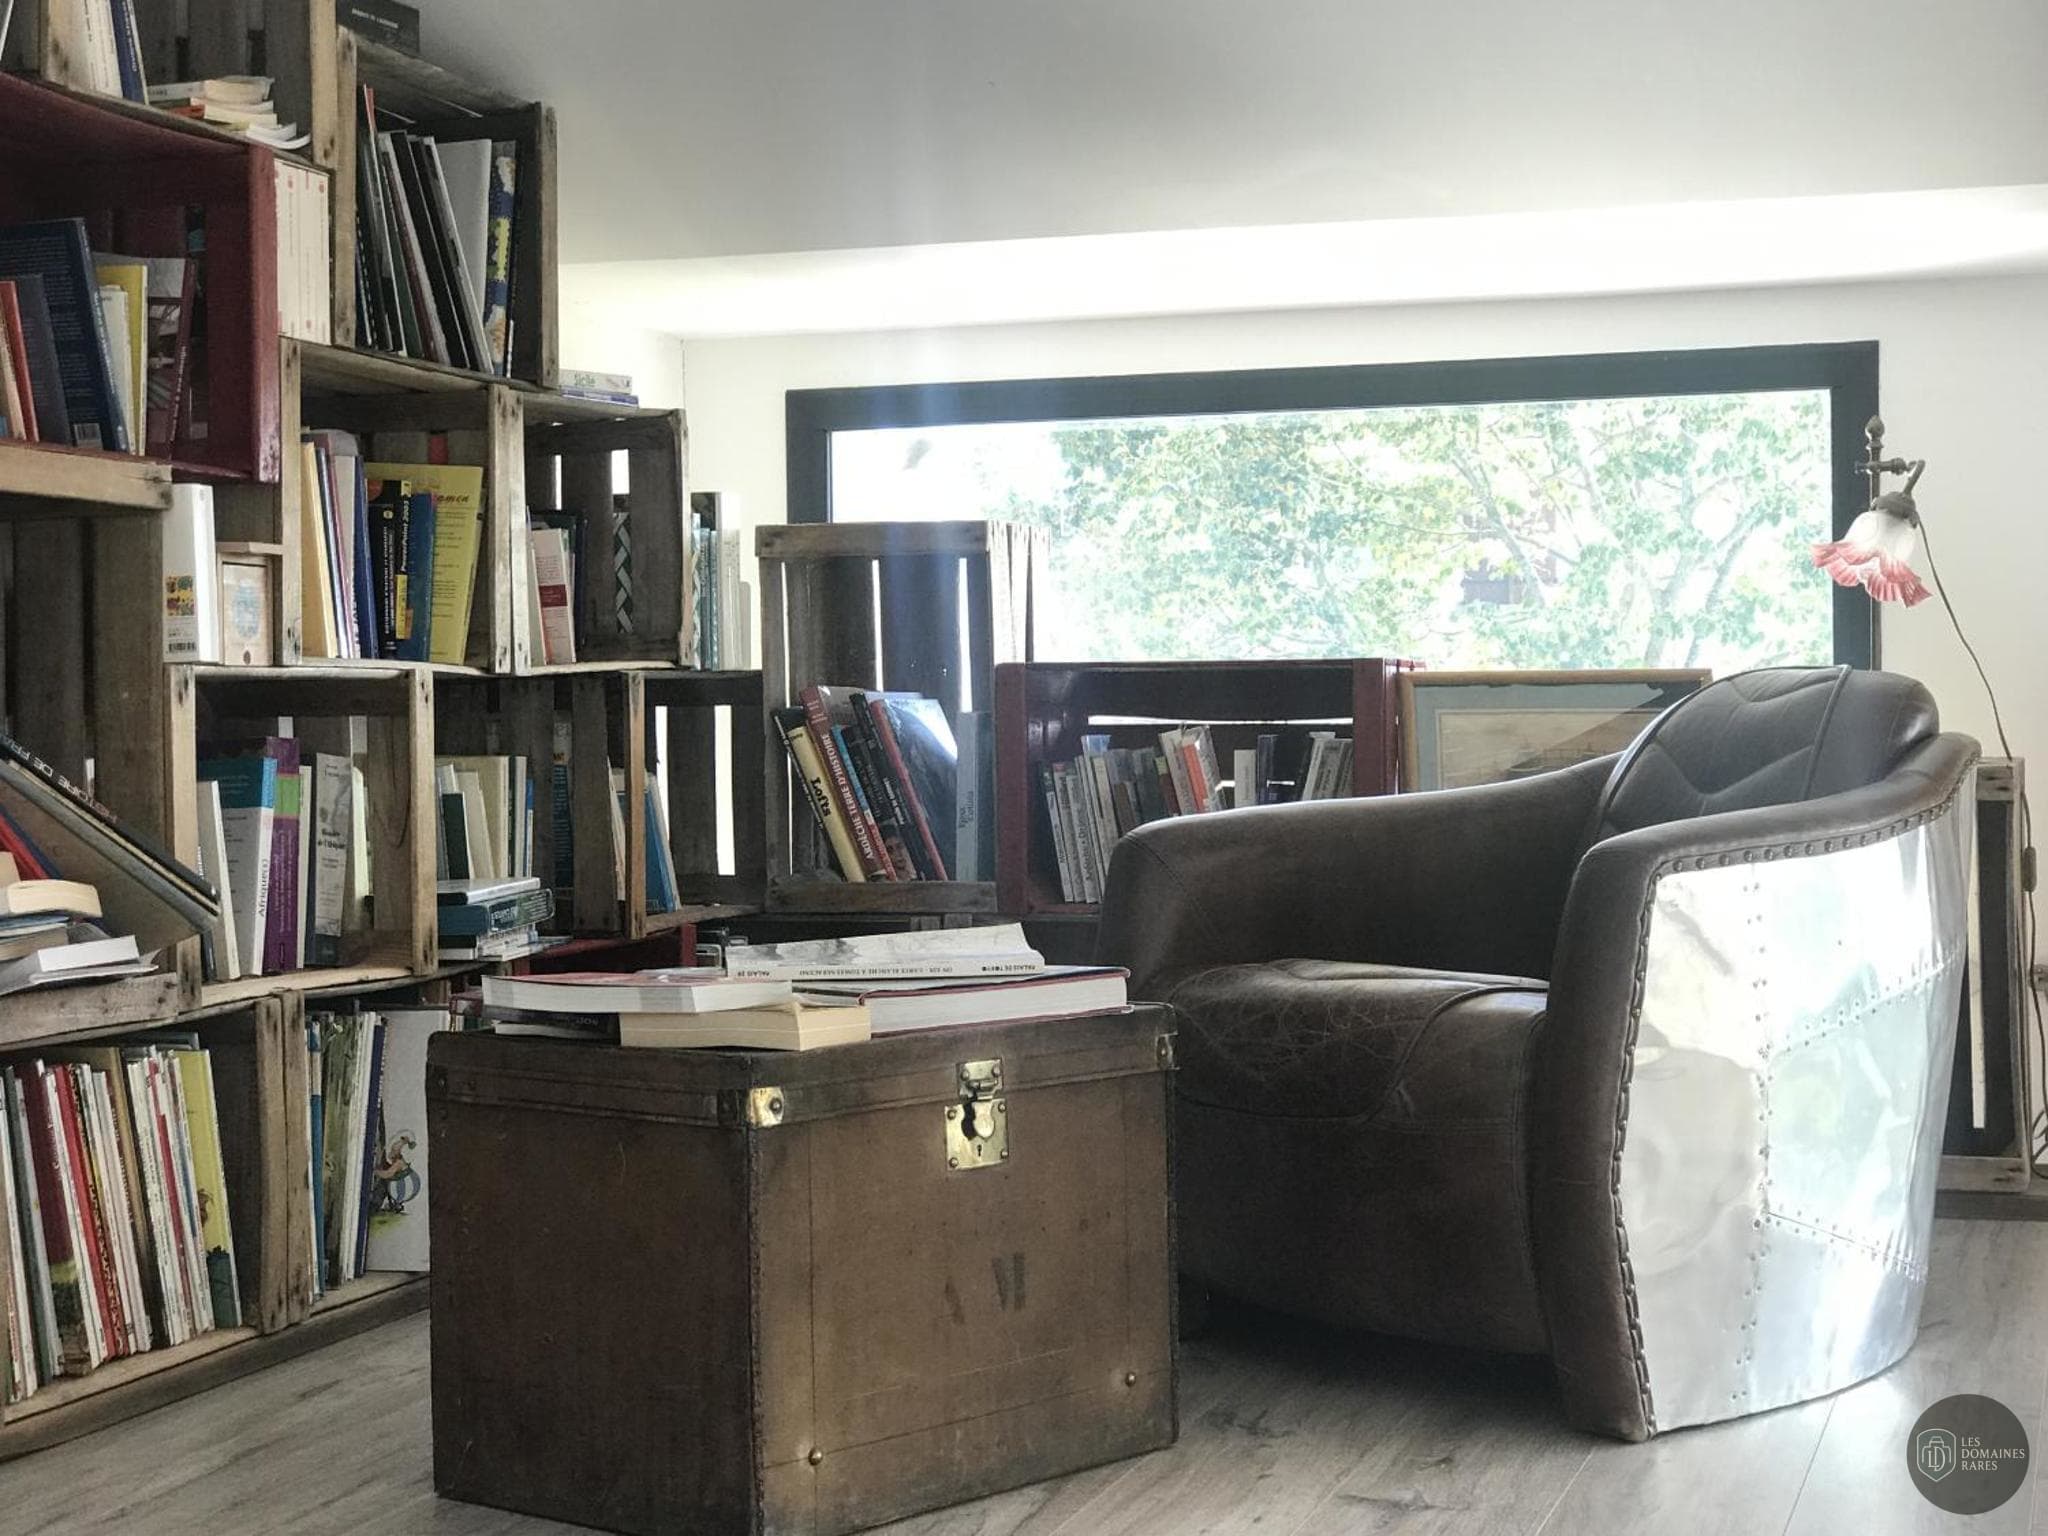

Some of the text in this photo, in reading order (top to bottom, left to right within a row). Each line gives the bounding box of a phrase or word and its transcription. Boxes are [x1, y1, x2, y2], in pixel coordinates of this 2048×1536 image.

[33, 757, 54, 778] DE
[821, 733, 847, 786] D'HISTOIRE
[57, 775, 120, 824] HISTOIRE
[810, 777, 831, 817] Lofts
[841, 785, 858, 816] TERRE
